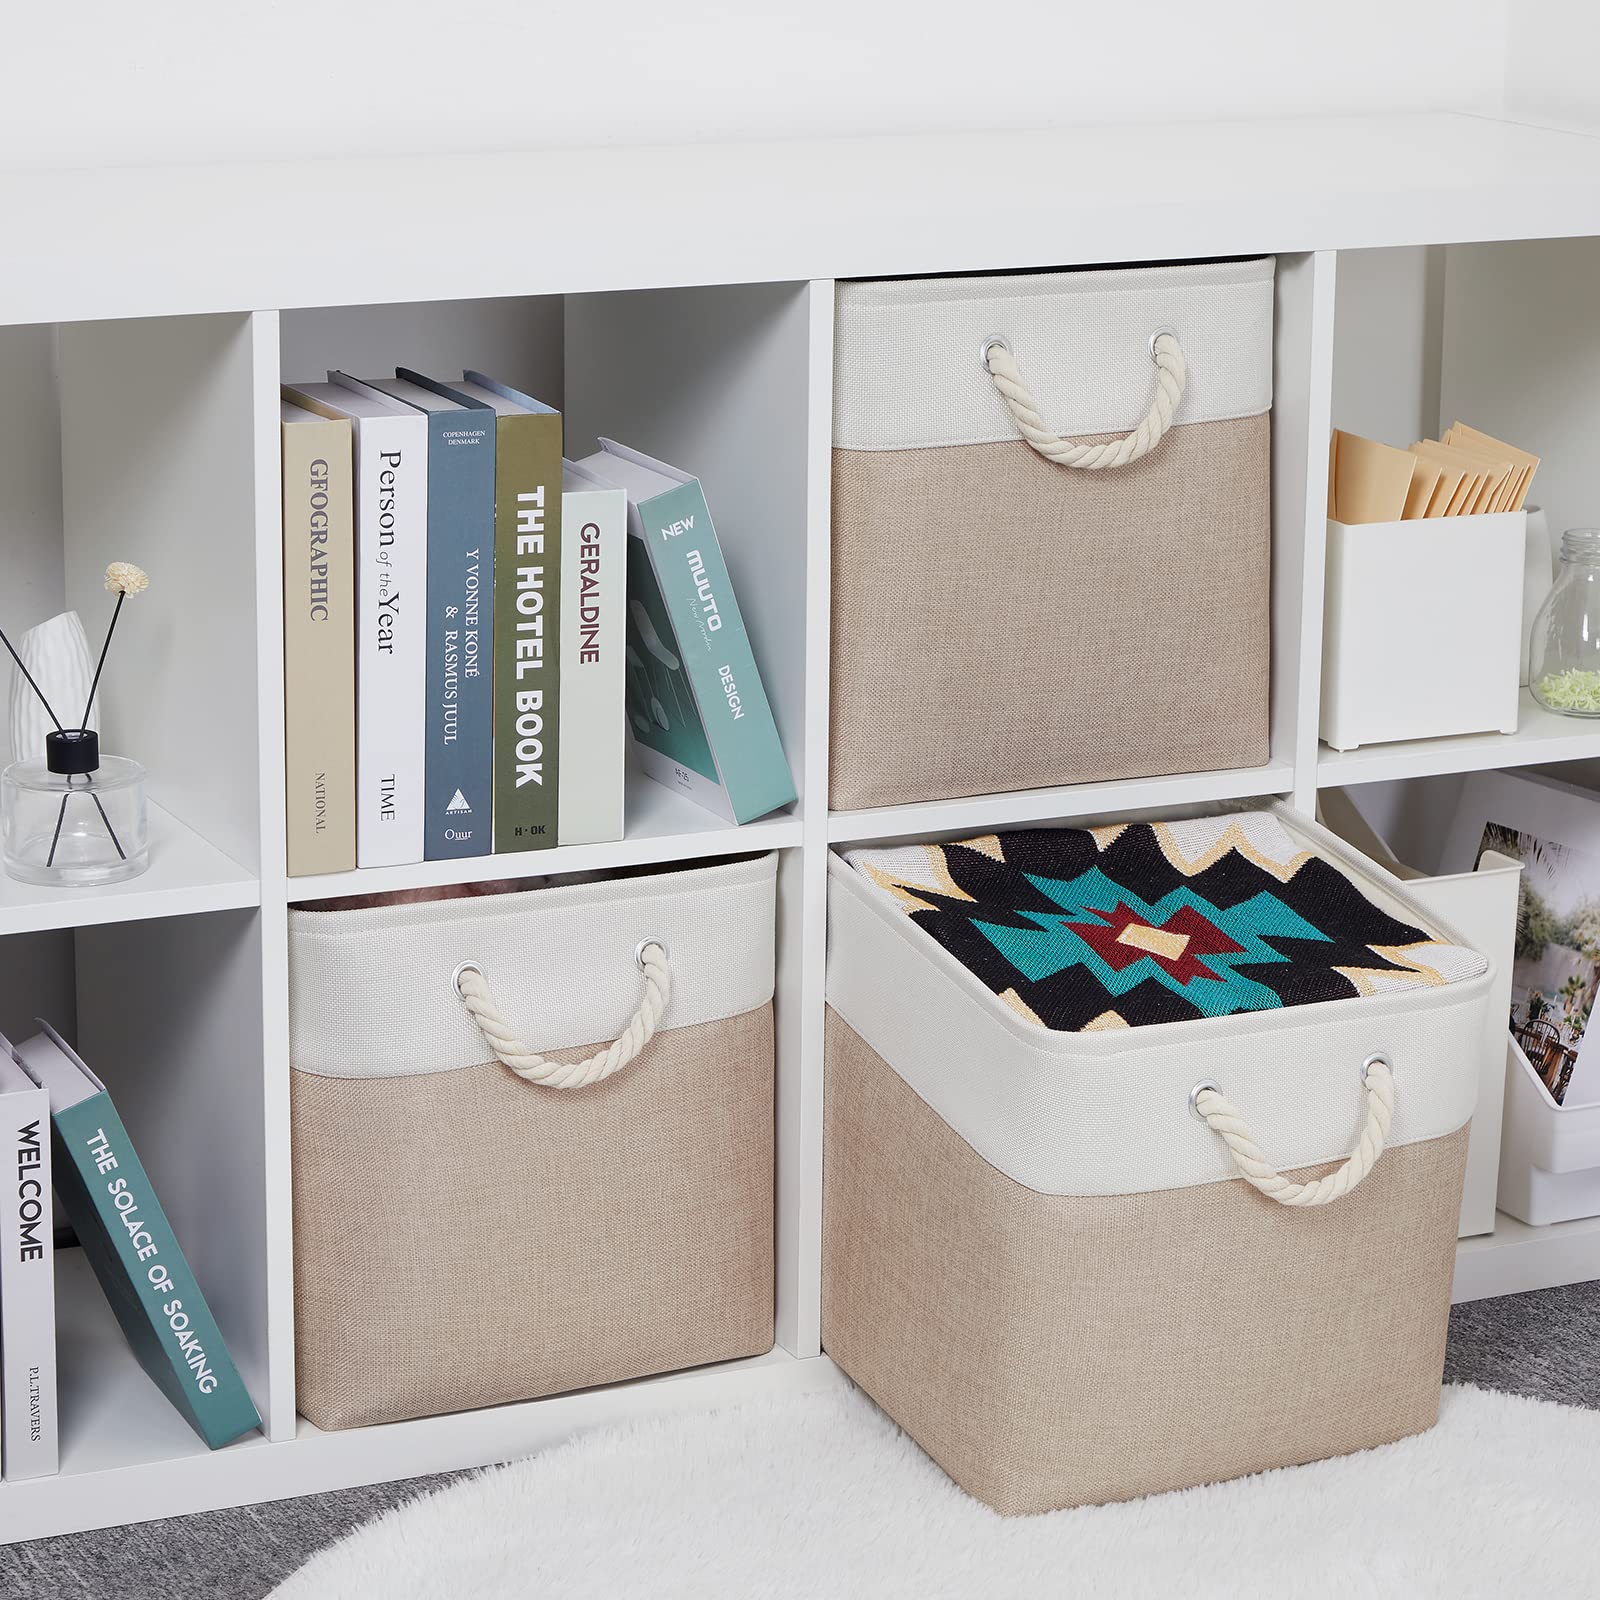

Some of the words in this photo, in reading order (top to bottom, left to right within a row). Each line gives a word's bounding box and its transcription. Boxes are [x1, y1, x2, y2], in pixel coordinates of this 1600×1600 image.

[442, 430, 486, 438] COPENHAGEN
[448, 438, 480, 446] DENMARK
[378, 449, 402, 548] Person
[516, 485, 545, 555] THE
[661, 515, 695, 541] NEW
[375, 551, 393, 568] of
[379, 573, 393, 597] the
[377, 592, 400, 655] Year
[445, 605, 459, 619] &
[515, 567, 545, 680] HOTEL
[579, 522, 601, 665] GERALDINE
[444, 630, 458, 699] RASMUS
[718, 664, 745, 720] DESIGN
[442, 703, 458, 745] JUUL
[514, 690, 544, 789] BOOK
[315, 772, 327, 834] NATIONAL
[380, 773, 396, 822] TIME
[17, 1119, 43, 1263] WELCOME
[86, 1128, 118, 1175] THE
[107, 1178, 158, 1262] SOLACE
[147, 1265, 174, 1294] OF
[163, 1300, 218, 1396] SOAKING
